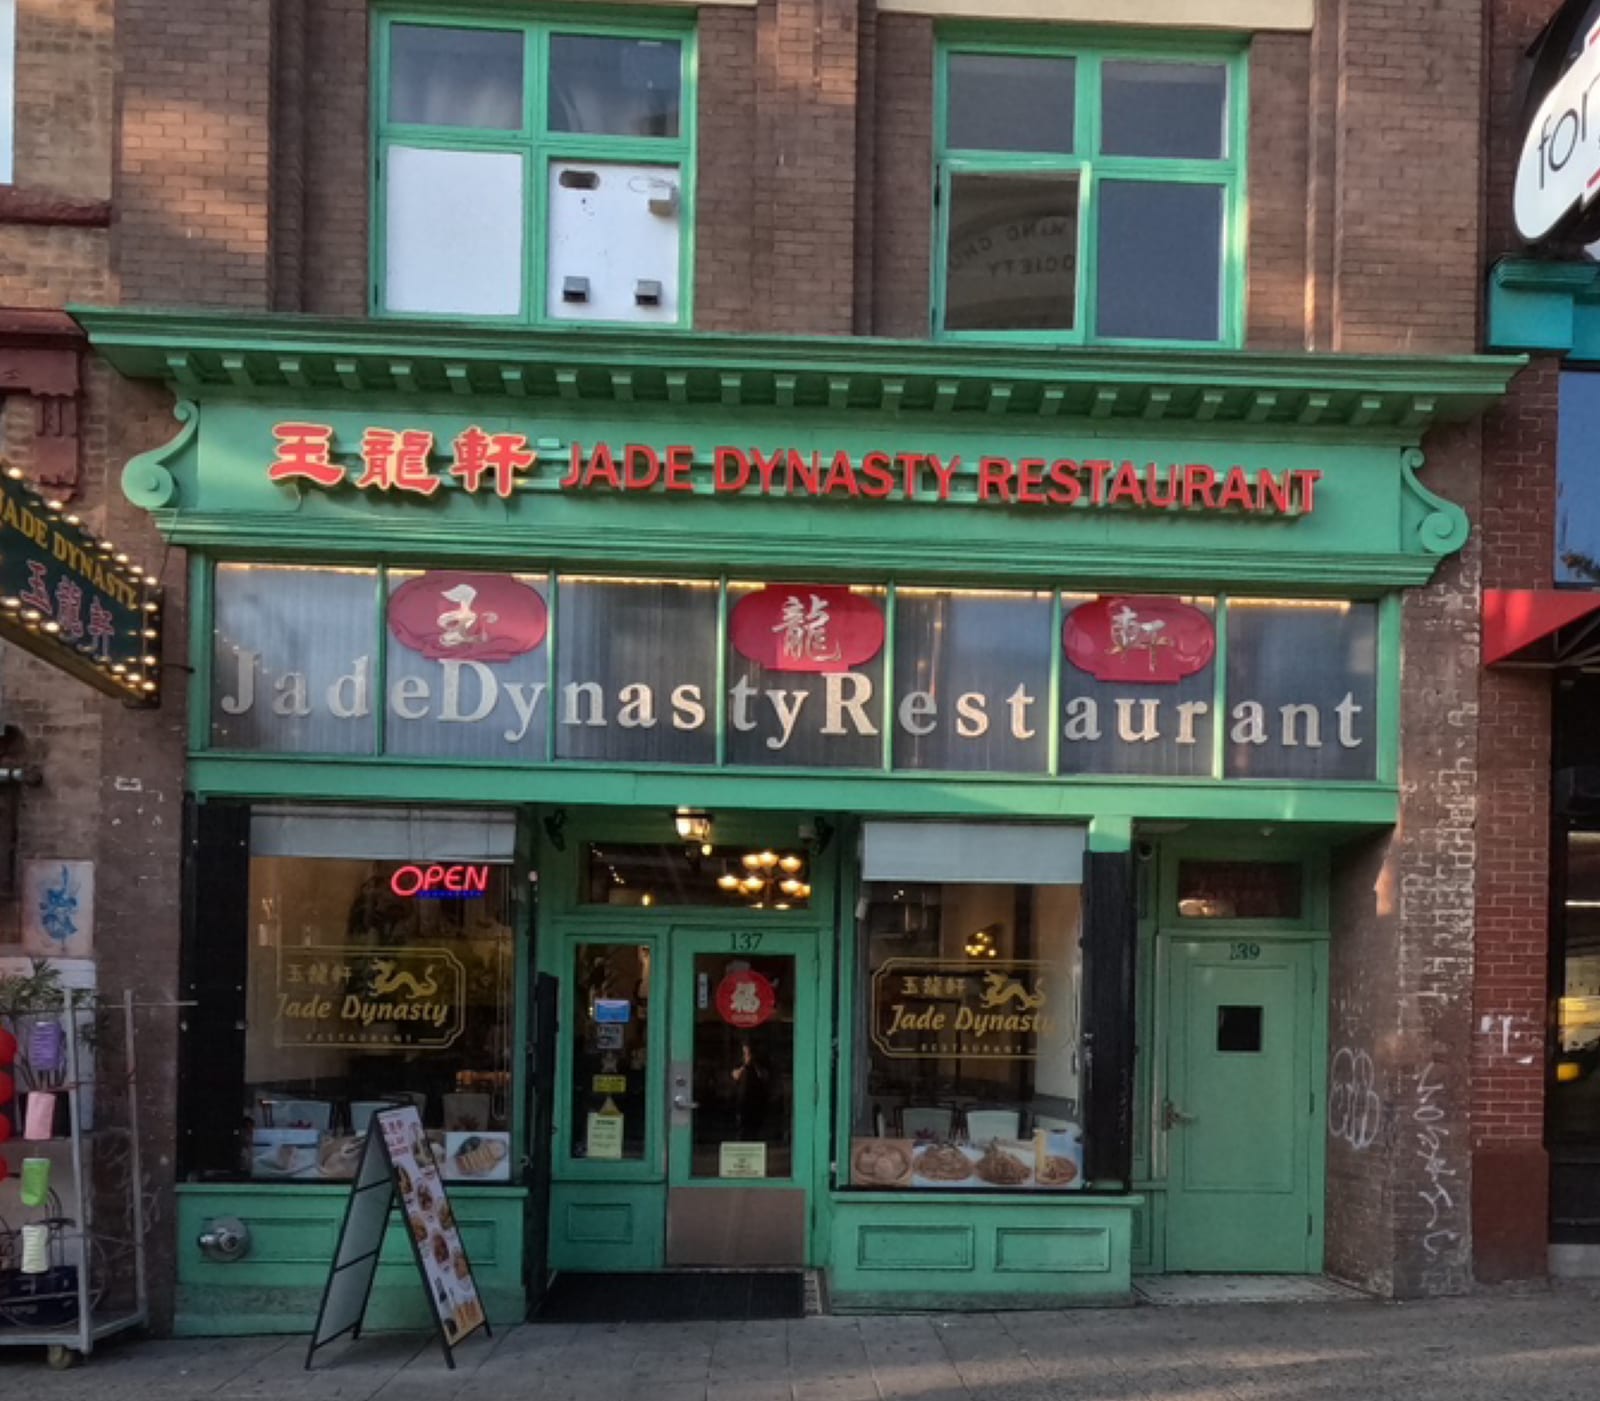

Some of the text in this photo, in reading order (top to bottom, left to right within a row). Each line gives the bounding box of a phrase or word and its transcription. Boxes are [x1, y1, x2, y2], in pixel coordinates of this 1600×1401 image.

[267, 422, 538, 498] 玉龍軒
[560, 441, 1323, 514] JADE DYNASTY RESTAURANT
[52, 530, 139, 611] DYNASTY
[771, 594, 842, 663] 龍
[391, 865, 489, 896] OPEN
[731, 932, 763, 951] 137
[1229, 942, 1261, 961] 139
[273, 992, 448, 1028] Jade Dynasty
[886, 1004, 945, 1036] Jade
